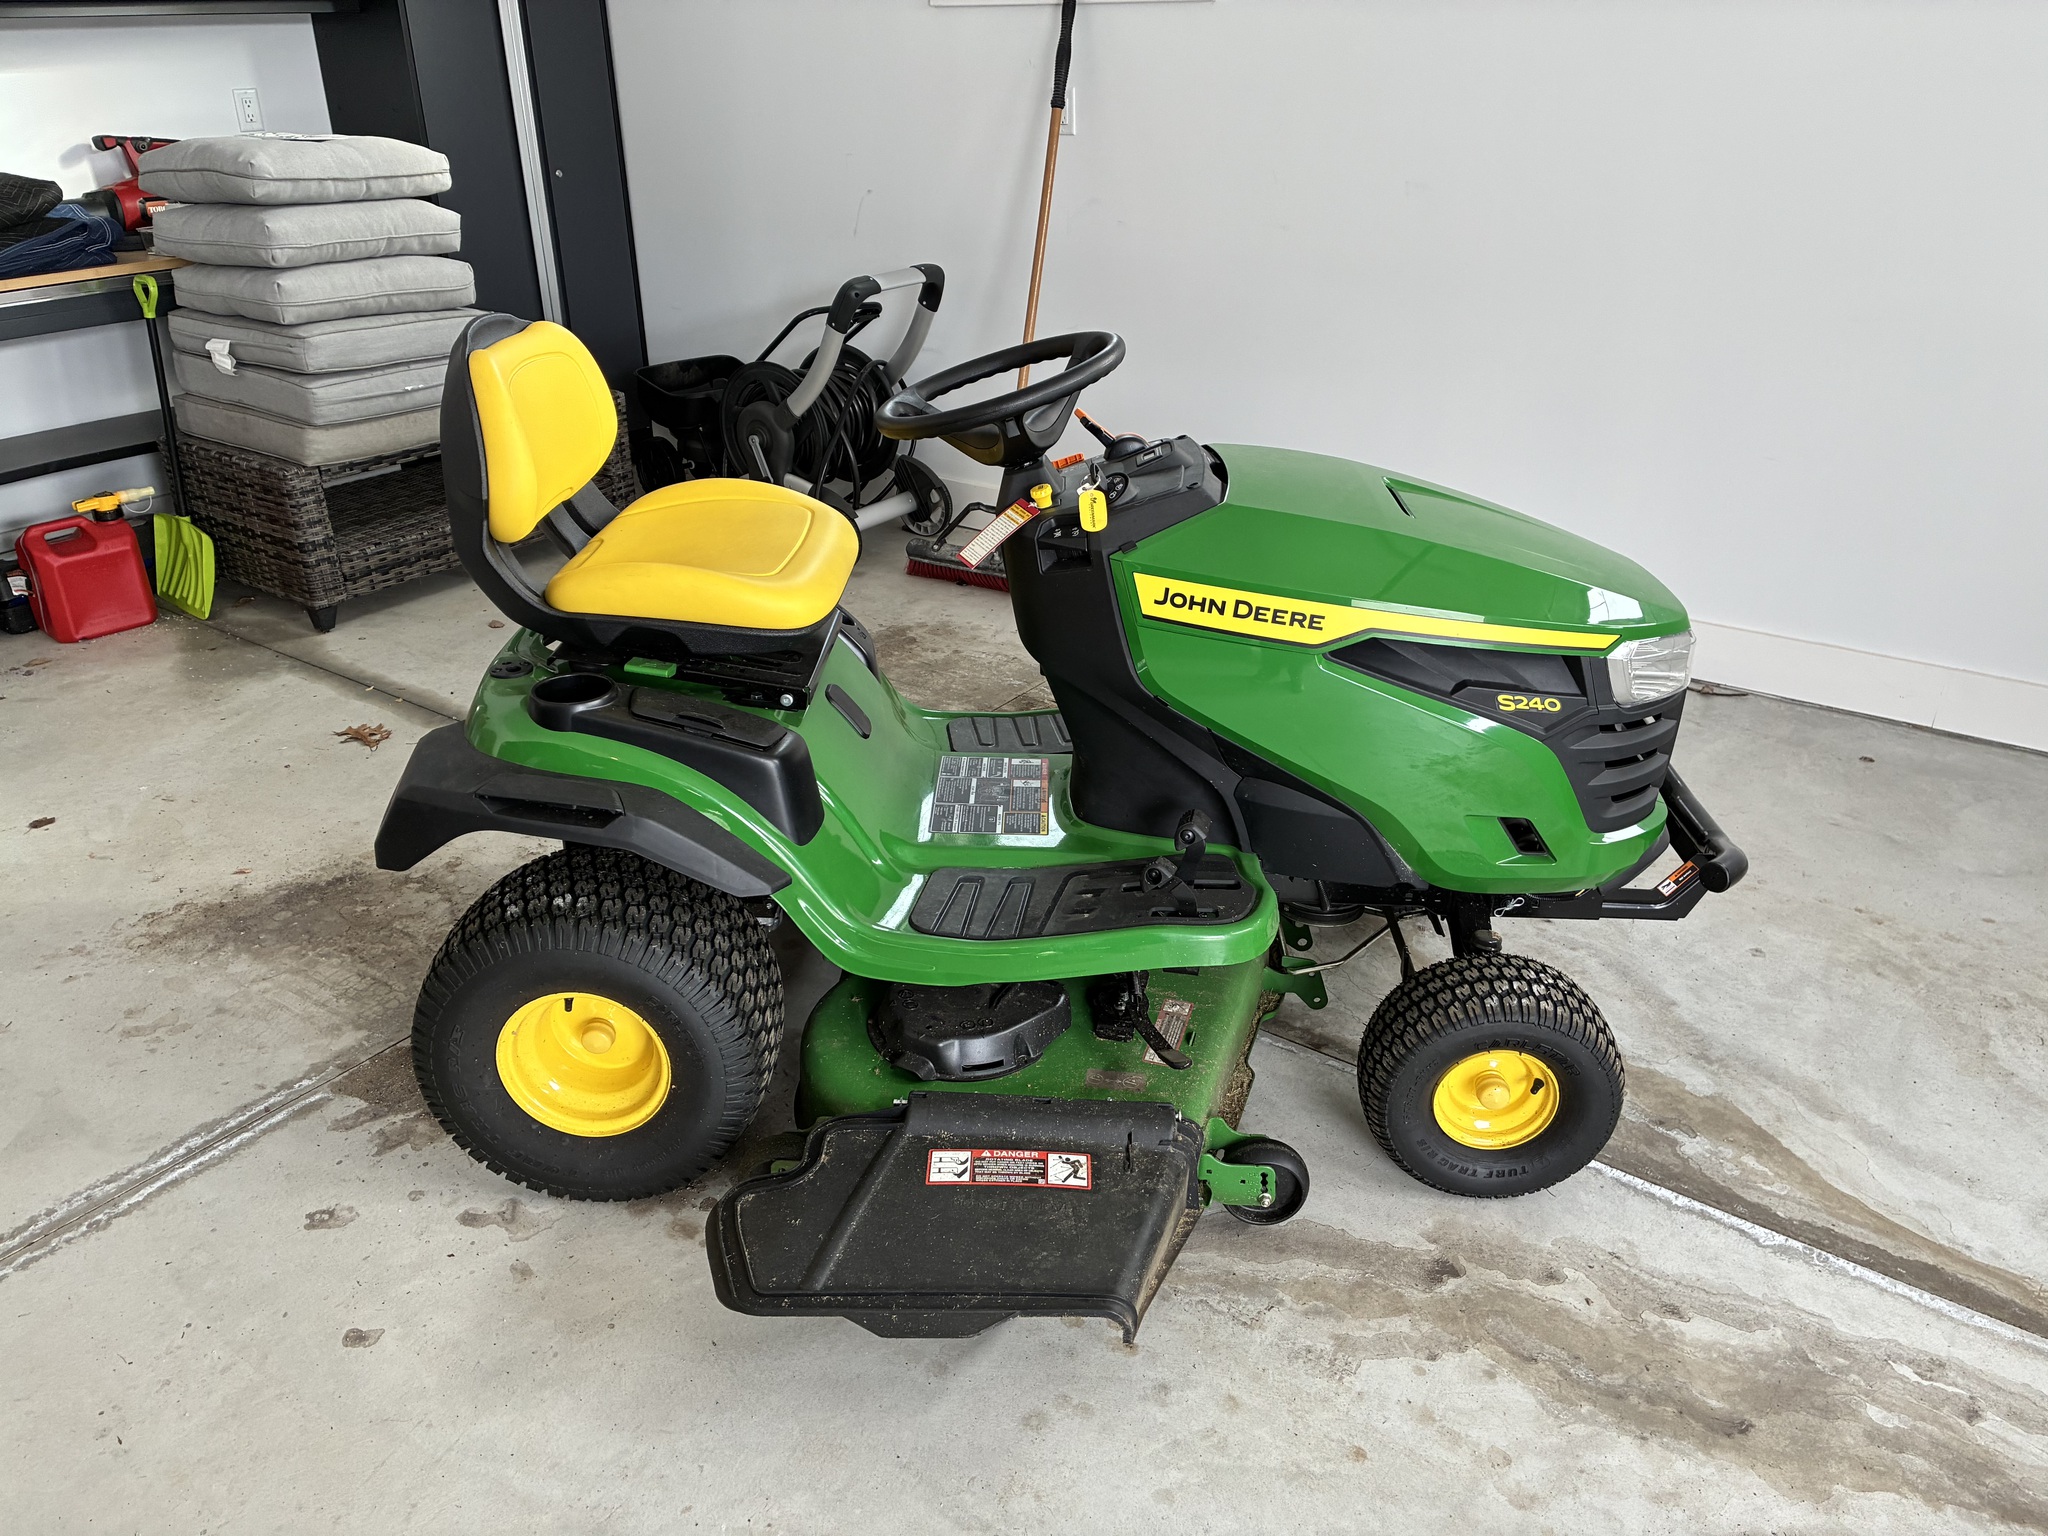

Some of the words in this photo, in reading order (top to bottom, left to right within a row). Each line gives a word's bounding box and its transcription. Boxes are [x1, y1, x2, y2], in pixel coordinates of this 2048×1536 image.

[1154, 587, 1226, 615] JOHN
[1232, 599, 1325, 631] DEERE
[1497, 694, 1561, 712] S240
[1474, 1037, 1581, 1077] CARLSTAR
[993, 1150, 1039, 1158] DANGER
[1438, 1157, 1479, 1178] TRAC
[1483, 1164, 1529, 1179] TURF
